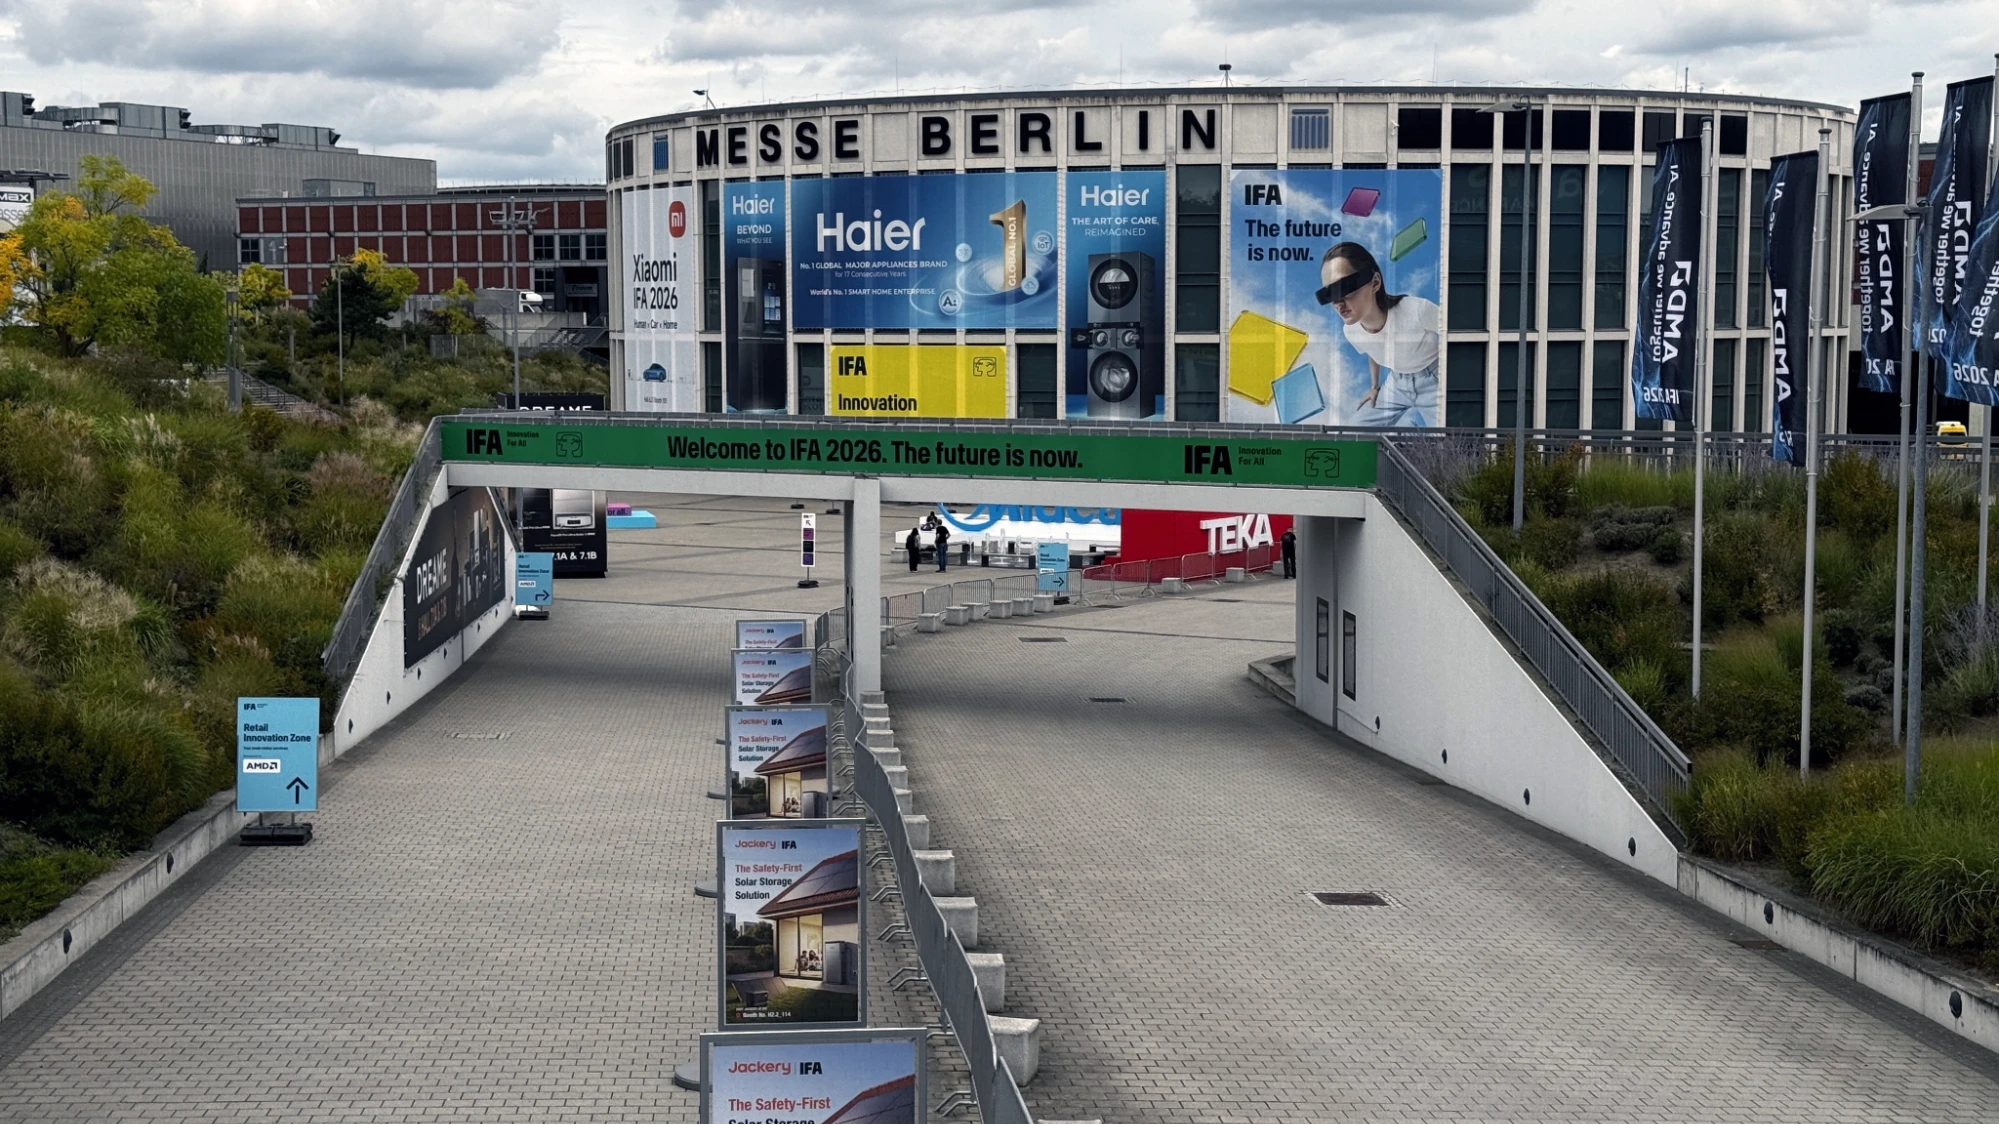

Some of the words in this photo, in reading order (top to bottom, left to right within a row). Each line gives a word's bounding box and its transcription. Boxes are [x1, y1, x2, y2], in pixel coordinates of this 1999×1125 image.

[697, 120, 859, 167] MESSE
[922, 109, 1215, 156] BERLIN
[1081, 184, 1149, 206] Haier
[1245, 184, 1282, 205] IFA
[733, 194, 775, 215] Haier
[1008, 217, 1017, 240] NO.1
[1093, 217, 1112, 225] ART
[1115, 217, 1128, 225] OF
[1131, 216, 1159, 226] CARE,
[1245, 219, 1280, 237] The
[1285, 219, 1342, 237] future
[737, 224, 772, 235] BEYOND
[817, 209, 926, 252] Haier
[1085, 228, 1146, 236] REIMAGINED
[763, 236, 772, 244] SEE
[1248, 243, 1264, 261] is
[1269, 247, 1314, 261] now.
[633, 252, 677, 282] Xiaomi
[1008, 243, 1017, 287] GLOBAL
[633, 288, 648, 310] IFA
[650, 287, 678, 310] 2026
[651, 319, 659, 329] Car
[663, 320, 678, 329] Home
[838, 356, 867, 376] IFA
[838, 394, 918, 411] Innovation
[507, 430, 539, 438] Innovation
[466, 429, 503, 456] IFA
[518, 439, 527, 447] All
[667, 436, 761, 460] Welcome
[765, 438, 785, 461] to
[790, 439, 822, 461] IFA
[826, 439, 888, 463] 2026.
[891, 440, 931, 464] The
[935, 442, 1000, 466] future
[1005, 443, 1024, 467] is
[1029, 449, 1083, 468] now.
[1238, 446, 1282, 456] Innovation
[1184, 445, 1233, 475] IFA
[1238, 457, 1252, 465] For
[1253, 457, 1265, 466] All
[1200, 513, 1275, 556] TEKA
[570, 552, 578, 560] &
[580, 551, 597, 559] 7.1B
[416, 548, 447, 604] DREAME
[243, 703, 256, 711] IFA
[244, 723, 268, 732] Retail
[244, 734, 288, 742] Innovation
[290, 734, 311, 742] Zone
[246, 762, 269, 770] AMD
[735, 840, 776, 849] Jackery
[781, 841, 797, 849] IFA
[735, 864, 751, 873] The
[752, 864, 802, 874] Safety-First
[735, 877, 757, 887] Solar
[759, 877, 792, 888] Storage
[735, 891, 770, 900] Solution
[728, 1061, 791, 1075] Jackery
[800, 1062, 823, 1075] IFA
[728, 1098, 752, 1111] The
[755, 1097, 831, 1113] Safety-First
